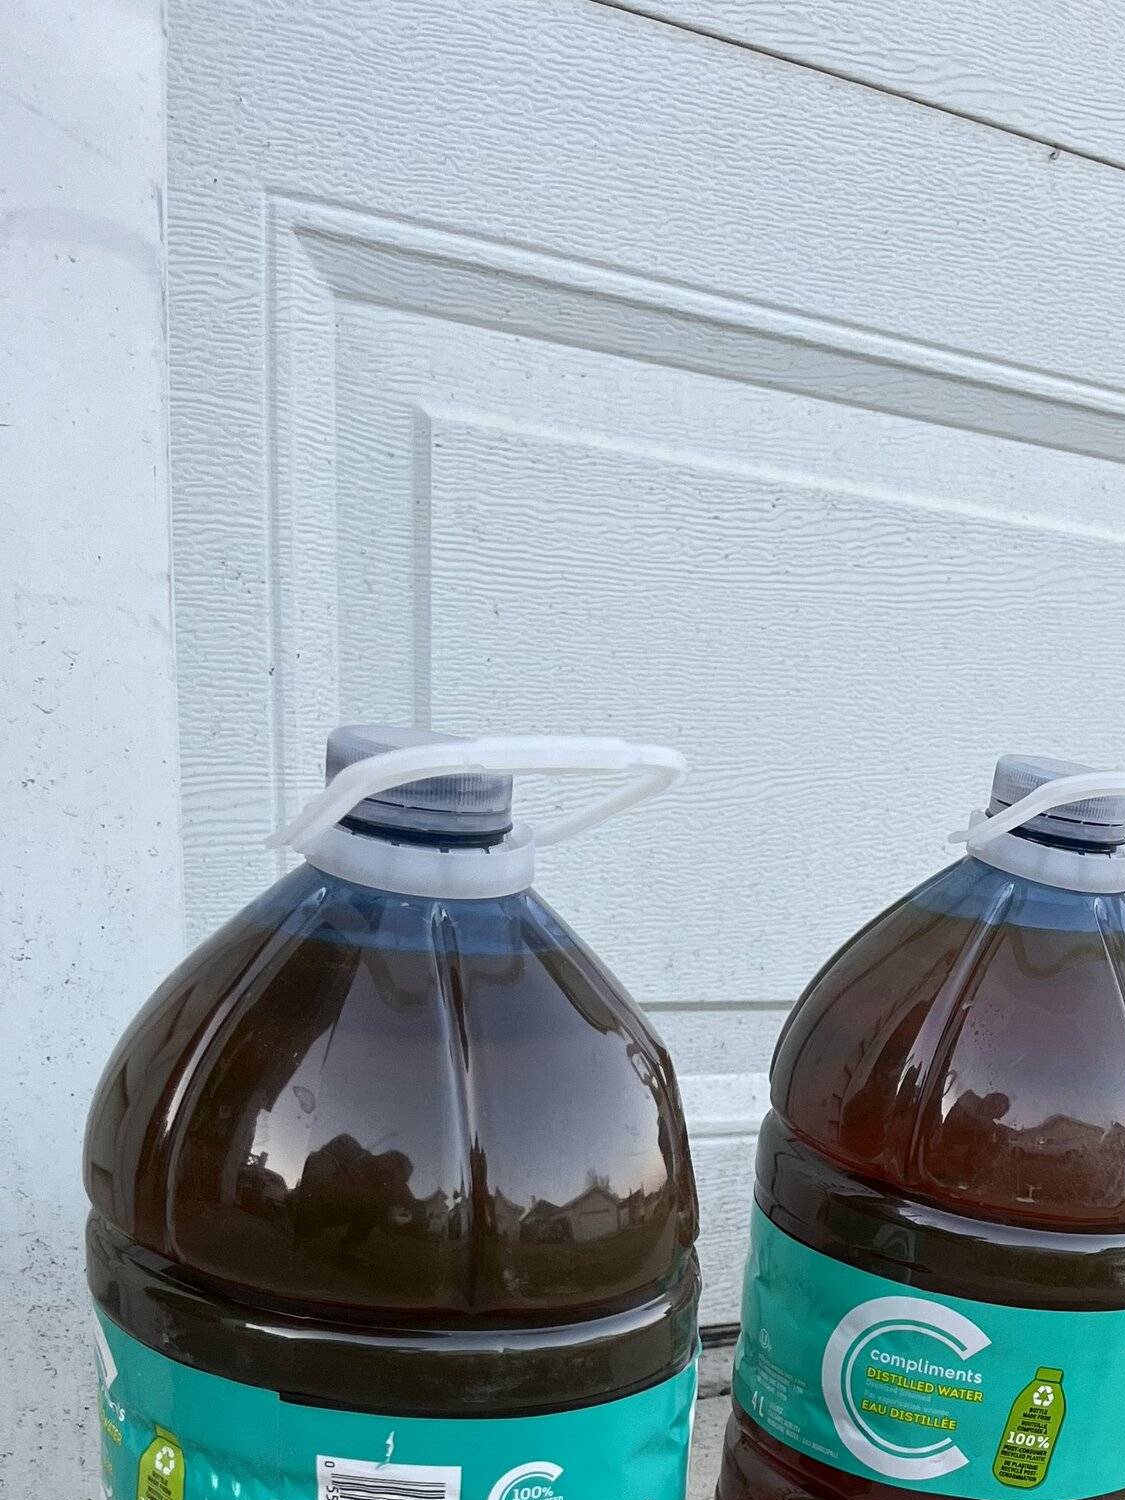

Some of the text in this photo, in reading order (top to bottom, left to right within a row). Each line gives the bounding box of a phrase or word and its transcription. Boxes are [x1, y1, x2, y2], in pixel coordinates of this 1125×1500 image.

[870, 1349, 983, 1384] compliments
[867, 1367, 934, 1393] DISTILLED
[938, 1385, 983, 1402] WATER
[862, 1399, 886, 1415] EAU
[890, 1408, 956, 1430] DISTILLÉE
[1007, 1431, 1050, 1449] 100%
